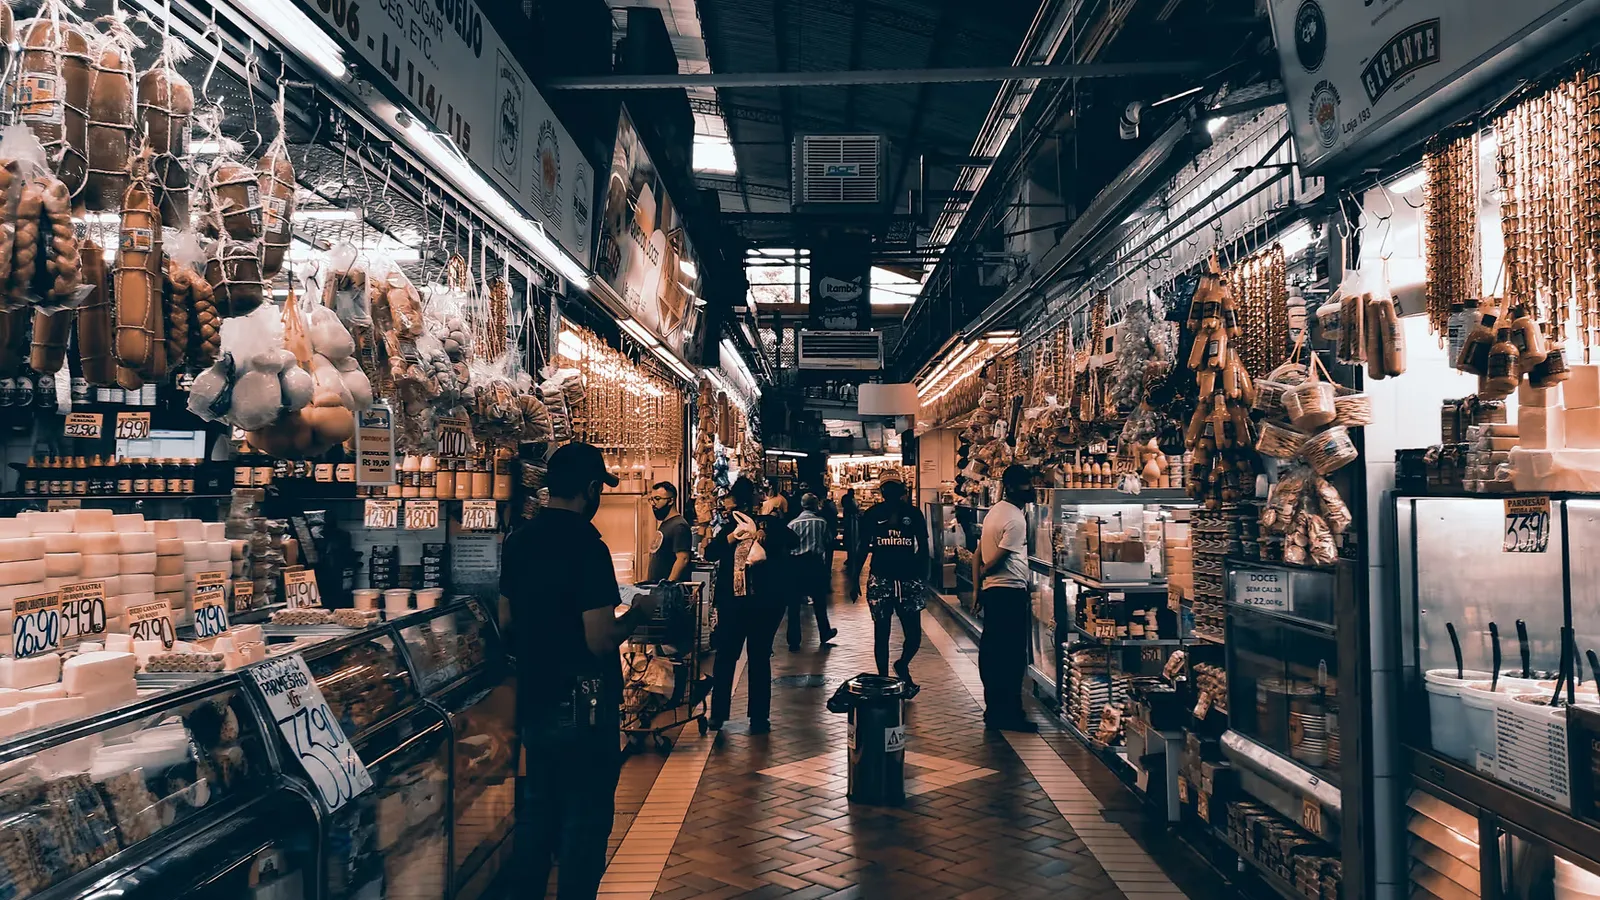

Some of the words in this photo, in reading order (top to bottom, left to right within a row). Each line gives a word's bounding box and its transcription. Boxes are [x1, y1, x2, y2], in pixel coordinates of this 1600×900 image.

[381, 32, 400, 81] LJ
[1366, 27, 1435, 98] GIGANTE
[1342, 118, 1358, 134] Loja
[1358, 107, 1371, 123] 193
[876, 537, 912, 546] Emirates
[888, 529, 901, 538] Fly
[1250, 574, 1278, 582] DOCES
